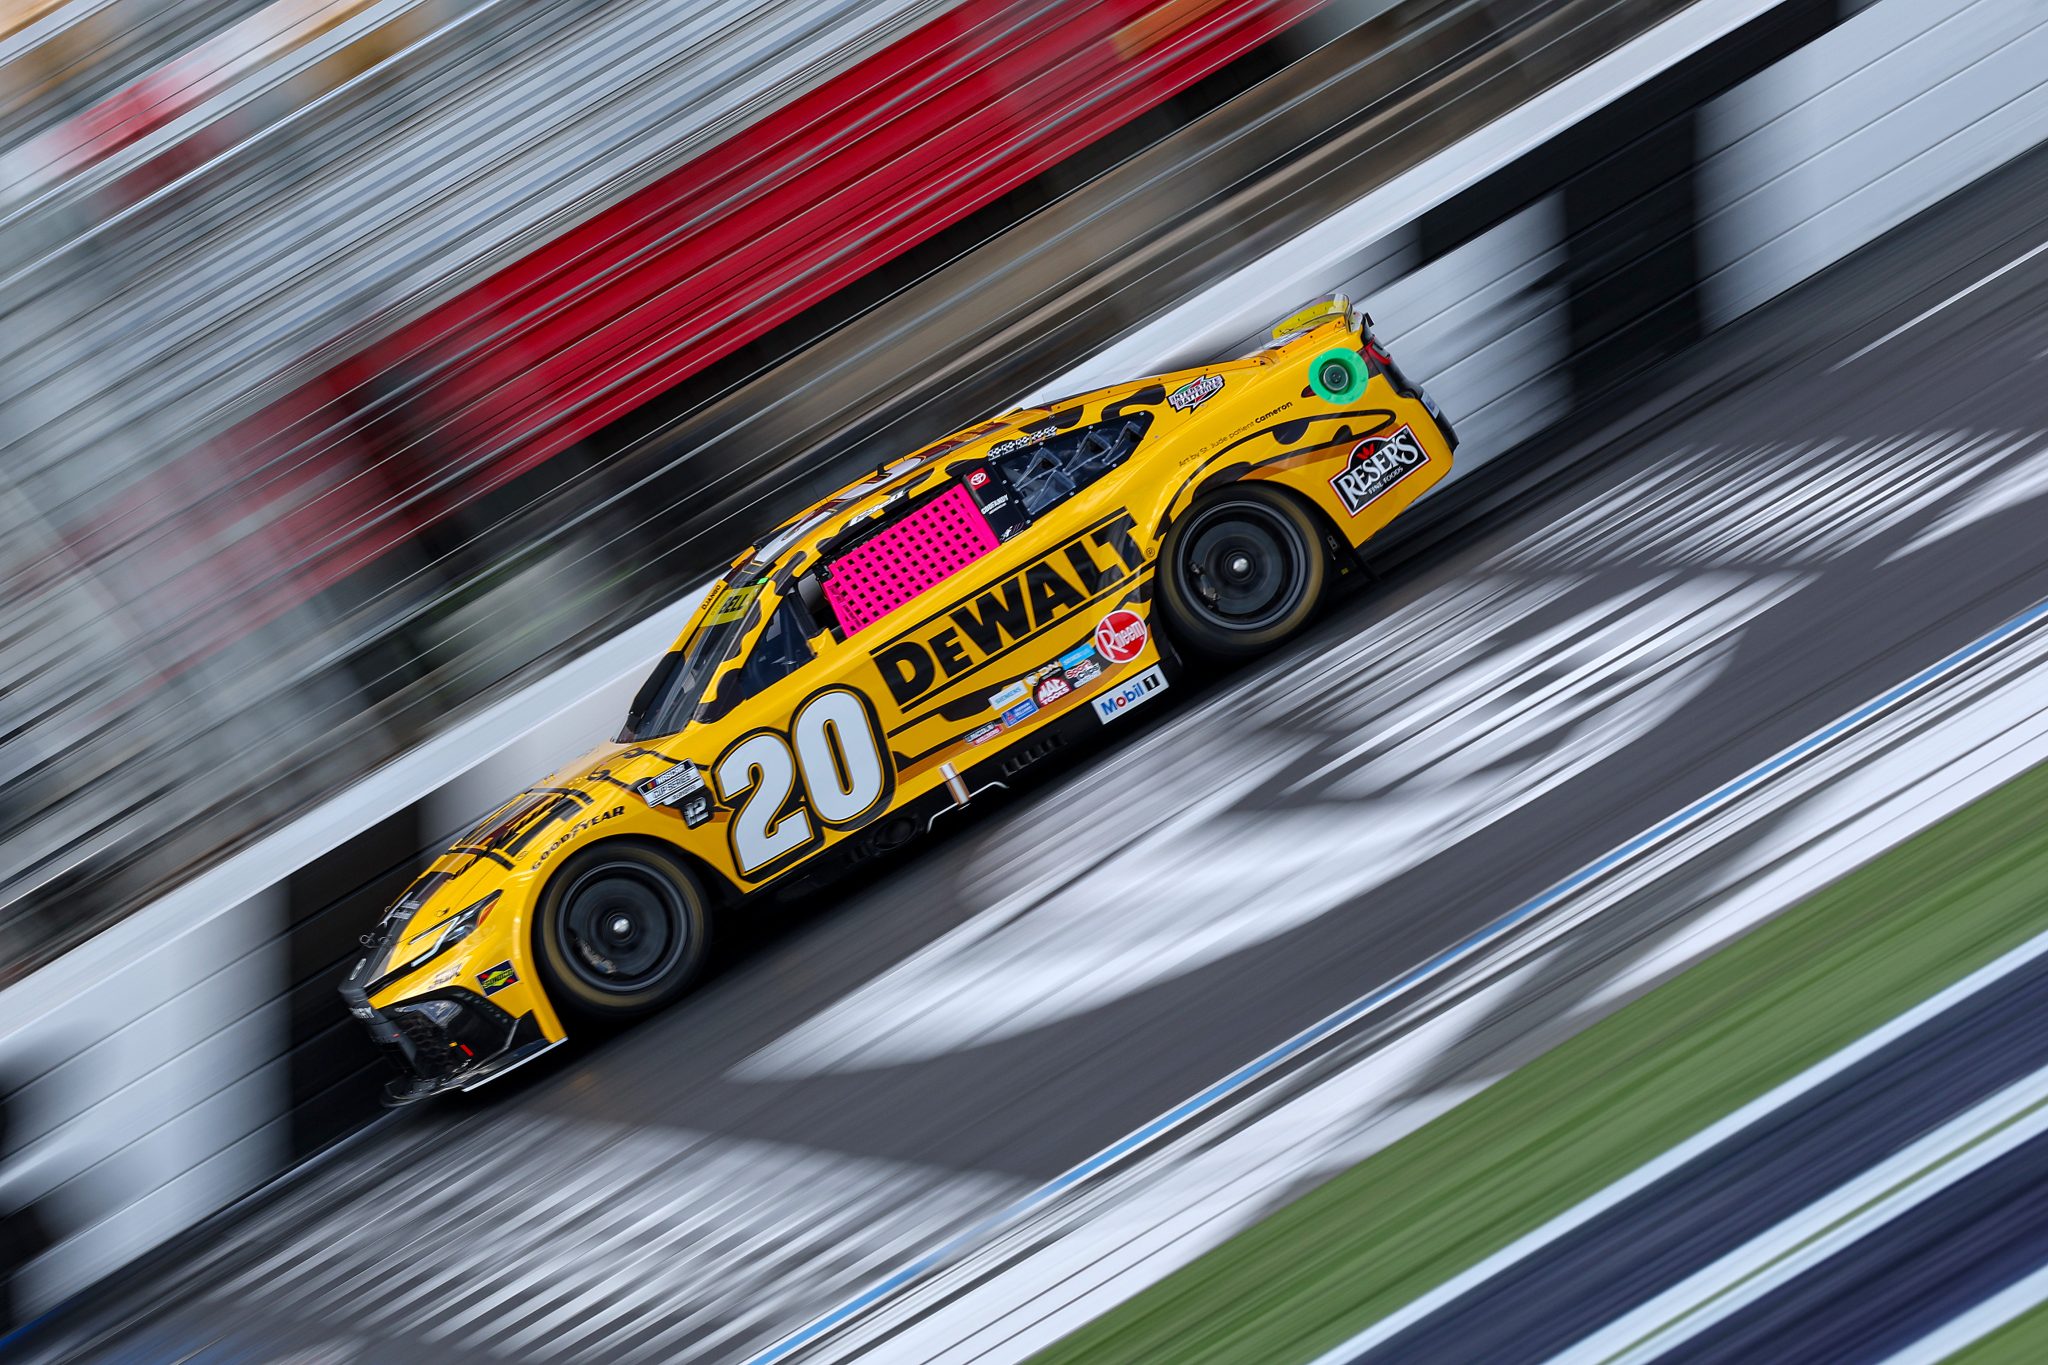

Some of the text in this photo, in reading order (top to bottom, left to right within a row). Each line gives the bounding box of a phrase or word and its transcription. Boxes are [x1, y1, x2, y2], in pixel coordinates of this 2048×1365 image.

[1170, 376, 1223, 405] INTERSTATE
[1176, 382, 1222, 410] BATTERIES
[1229, 421, 1255, 439] patient
[1338, 434, 1418, 508] RESER'S
[1368, 467, 1404, 494] FINE FOODS
[719, 593, 750, 614] BELL
[1098, 618, 1146, 659] Rheem
[1066, 660, 1092, 679] Sport
[1078, 663, 1100, 681] Clips
[1038, 679, 1068, 699] MAC
[1041, 687, 1070, 705] TOOLS
[1100, 682, 1145, 715] Mobil
[655, 765, 686, 784] NASCAR
[667, 774, 691, 791] SERIES
[717, 690, 883, 875] 20
[532, 805, 625, 871] GOODYEAR
